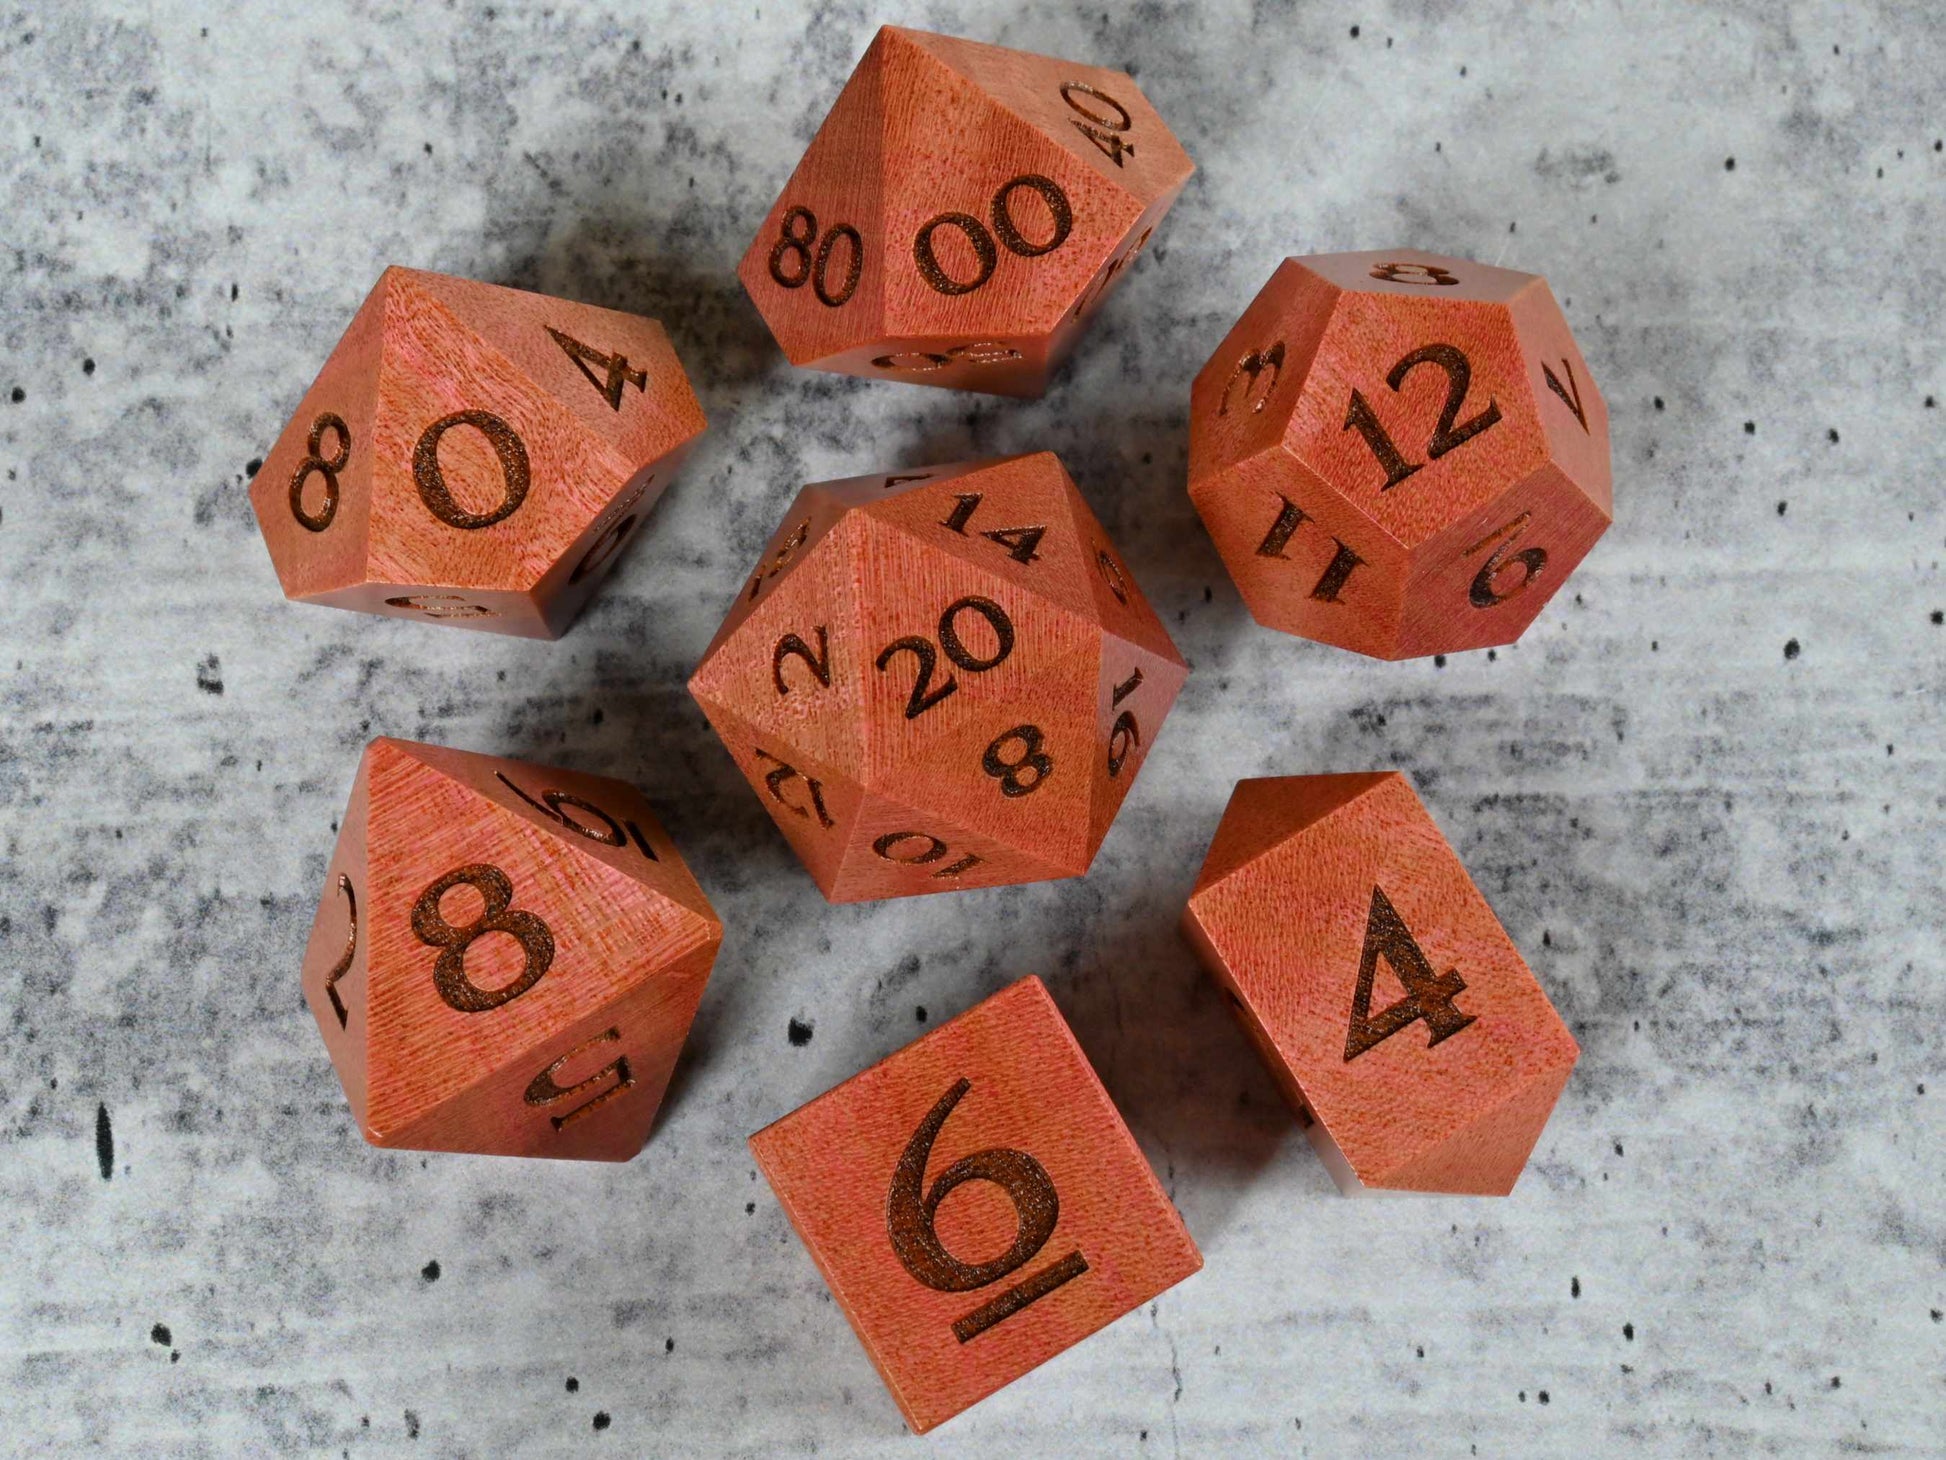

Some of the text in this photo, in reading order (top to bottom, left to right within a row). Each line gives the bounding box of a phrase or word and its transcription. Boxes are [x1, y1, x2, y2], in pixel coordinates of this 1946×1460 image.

[1059, 80, 1135, 168] 40
[768, 204, 864, 308] 80
[912, 173, 1073, 296] 00
[544, 324, 648, 412] 4
[1343, 343, 1503, 492] 12
[288, 412, 352, 533] 8
[412, 408, 531, 530] 0
[938, 492, 1048, 566] 14
[1255, 490, 1371, 605] 11
[772, 625, 831, 695] 2
[875, 594, 1016, 720] 20
[982, 723, 1053, 798] 8
[872, 831, 987, 881] 10
[411, 862, 556, 1013] 8
[1343, 883, 1479, 1064] 4
[523, 1026, 637, 1132] 5
[886, 1076, 1090, 1344] 6
